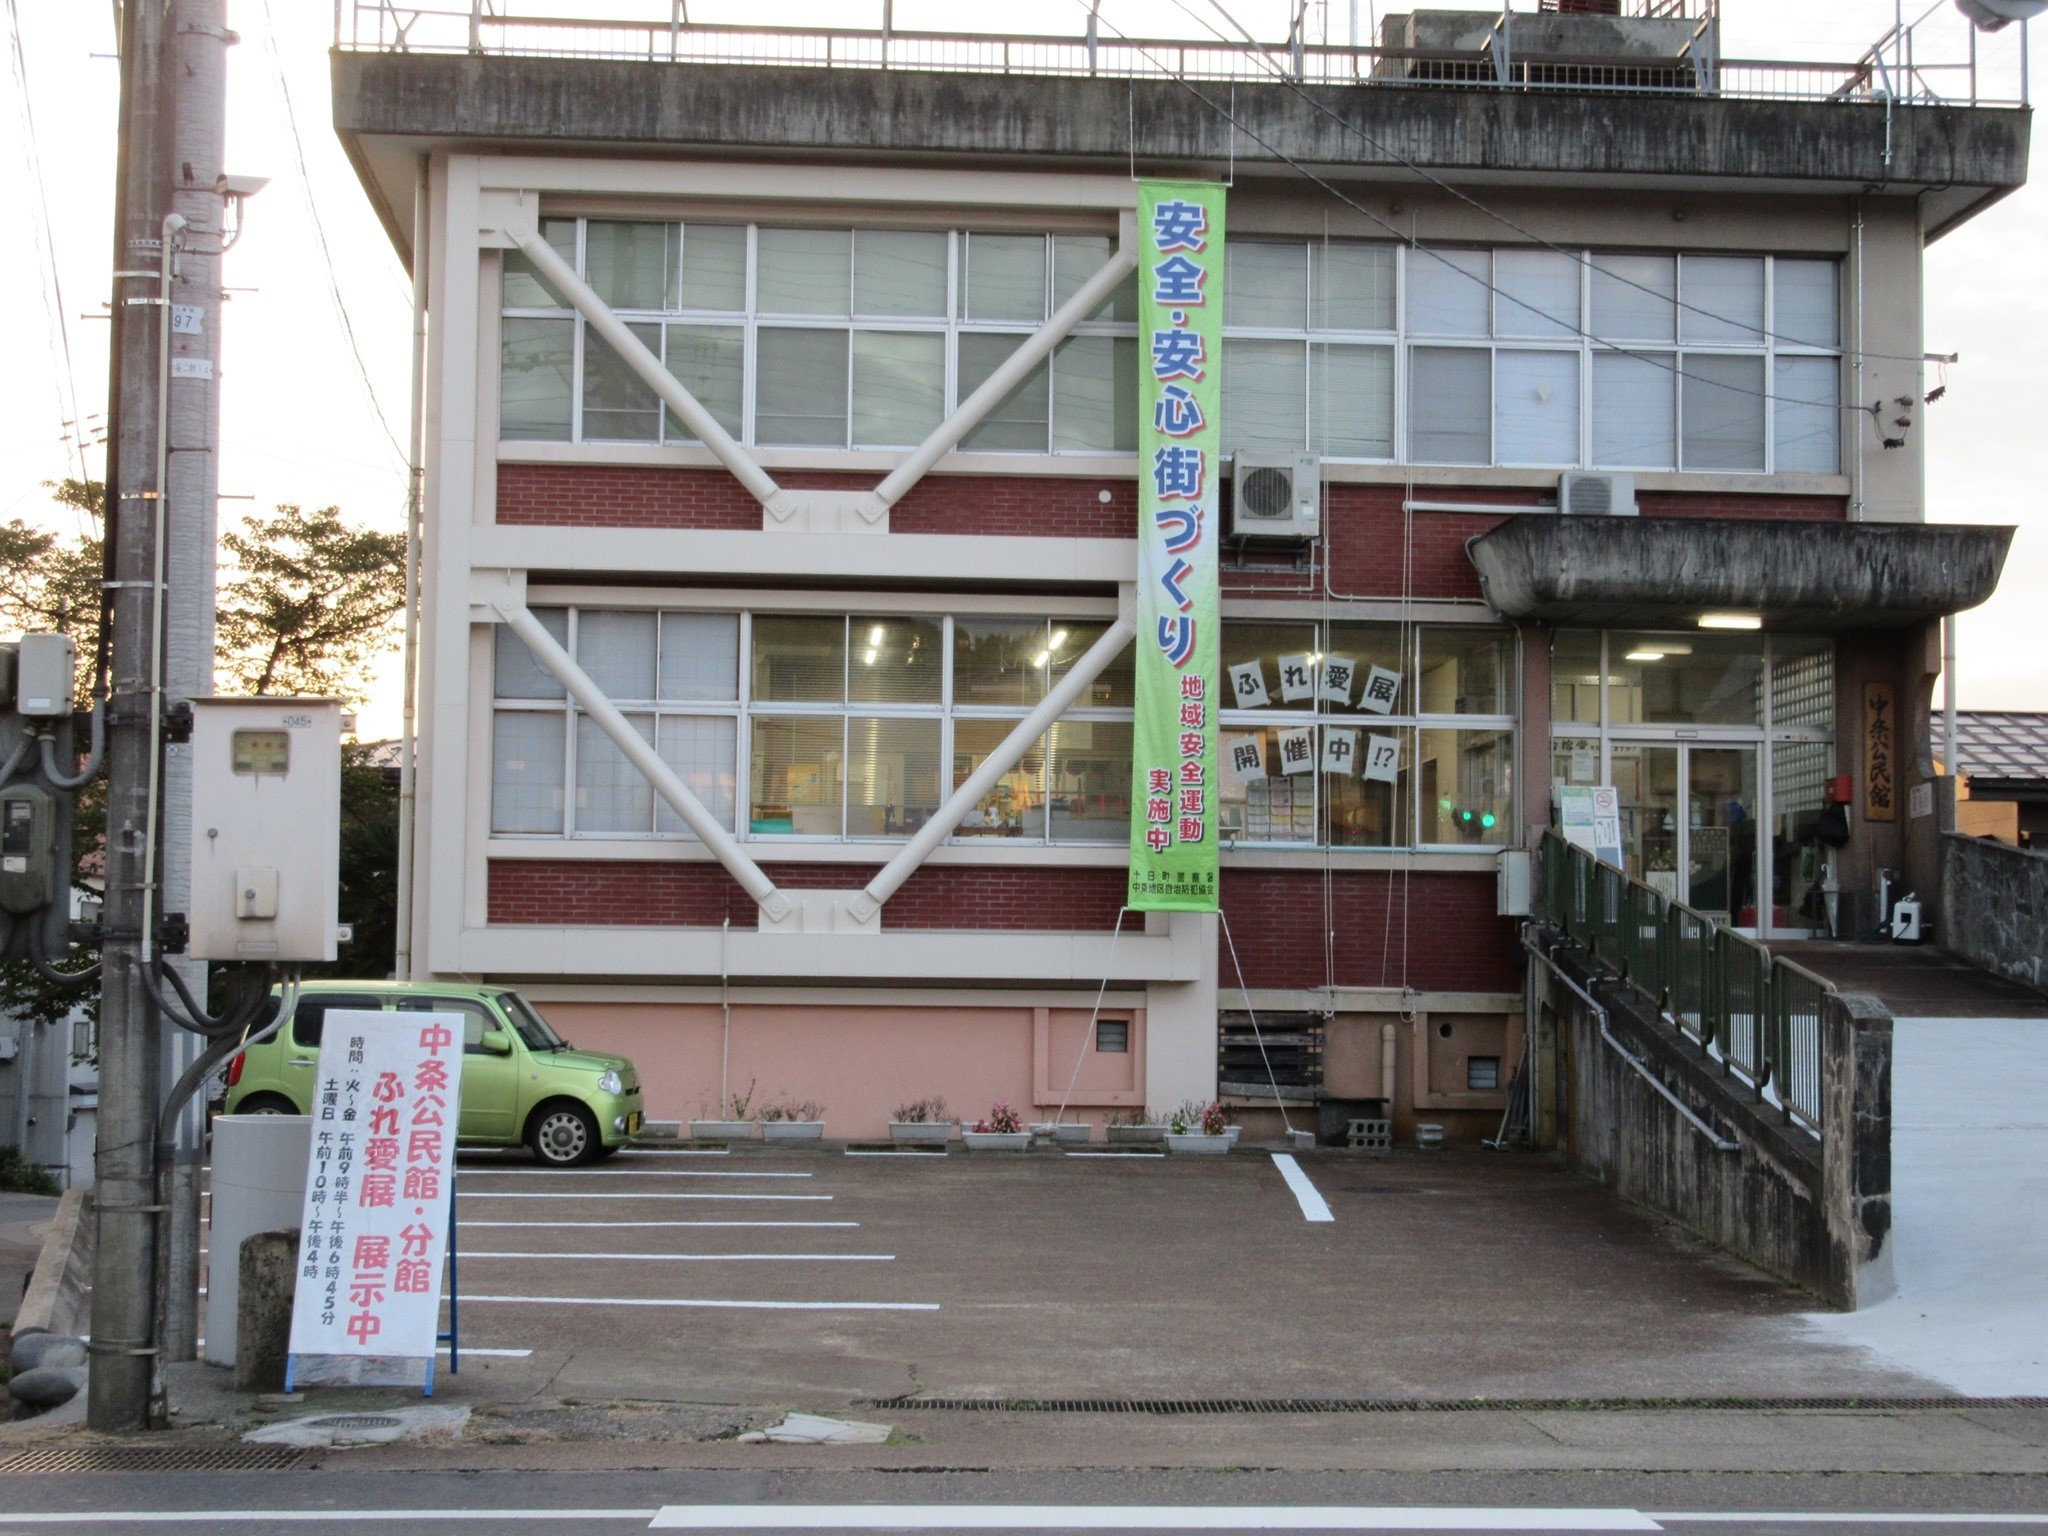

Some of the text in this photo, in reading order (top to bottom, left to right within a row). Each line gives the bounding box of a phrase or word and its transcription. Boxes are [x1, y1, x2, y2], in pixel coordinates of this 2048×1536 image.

[1153, 200, 1208, 669] 安全・安心街づくり
[1238, 665, 1397, 703] ふれ愛展
[1179, 675, 1204, 843] 地域安全運動
[1869, 693, 1892, 808] 中条公民館
[1146, 769, 1173, 853] 実施中
[1132, 882, 1214, 895] 中条地区自治防犯協会
[321, 1079, 339, 1122] 土曜日
[393, 1022, 453, 1294] 中条公民館・分館
[346, 1071, 406, 1346] ふれ愛展 展示中
